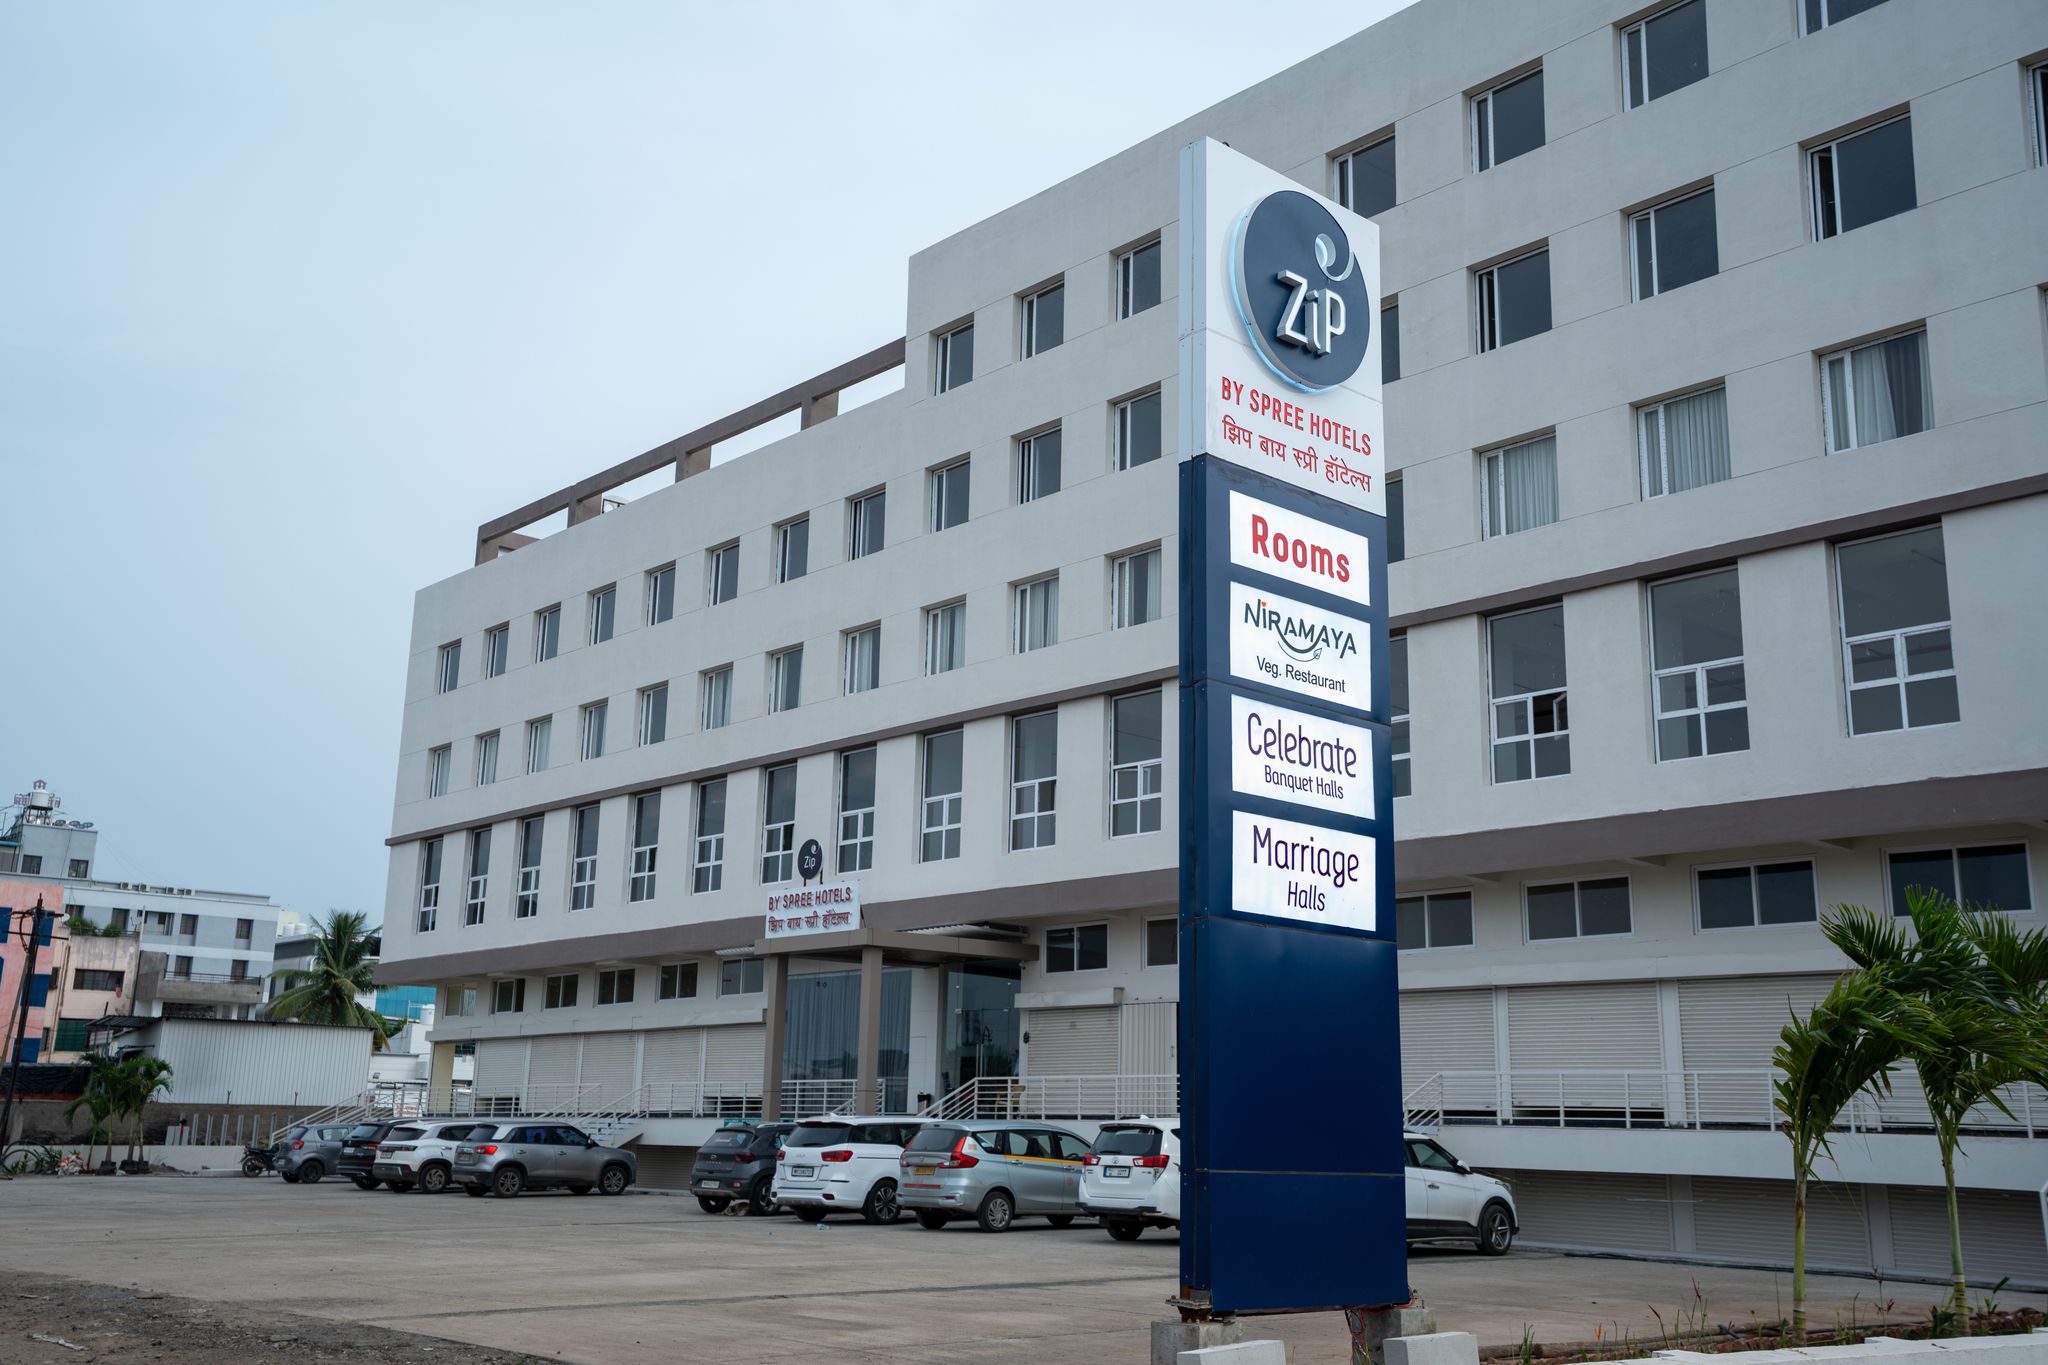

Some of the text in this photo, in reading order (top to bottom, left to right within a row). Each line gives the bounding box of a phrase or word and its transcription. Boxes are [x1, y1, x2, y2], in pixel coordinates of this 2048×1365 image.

[1221, 376, 1372, 456] BY SPREE HOTELS
[1222, 415, 1372, 493] झिप बाय स्प्री हॉटेल्स
[1251, 513, 1350, 583] Rooms
[1256, 655, 1346, 693] Veg. Restaurant
[1247, 712, 1357, 778] Celebrate
[1264, 764, 1344, 800] Banquet Halls
[1252, 824, 1359, 888] Marriage
[768, 887, 851, 911] BY SPREE HOTELS
[1287, 880, 1326, 912] Halls
